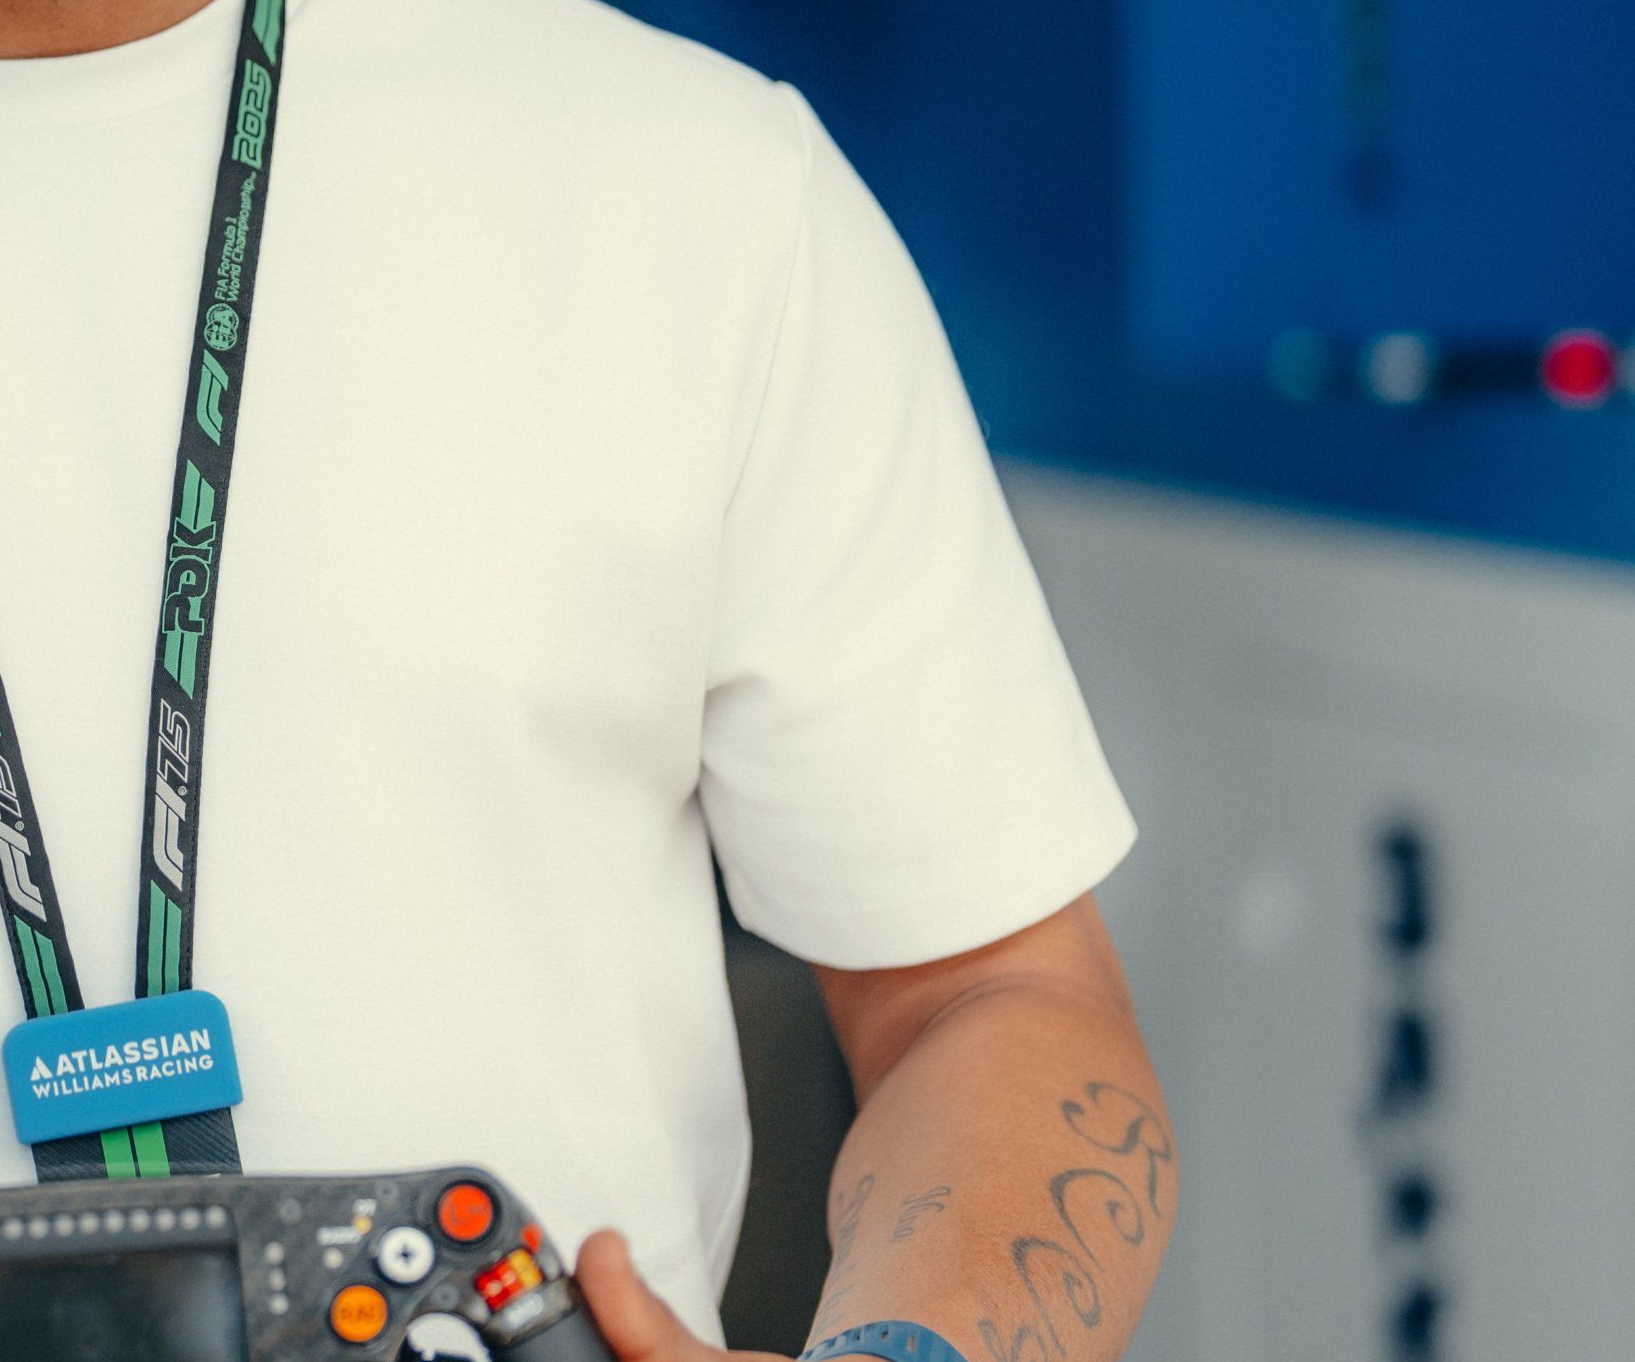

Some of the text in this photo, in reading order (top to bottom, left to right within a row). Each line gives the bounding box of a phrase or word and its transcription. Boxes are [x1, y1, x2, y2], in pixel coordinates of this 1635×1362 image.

[231, 58, 272, 171] 2025
[217, 229, 237, 278] Formula
[226, 263, 242, 303] World
[31, 1054, 214, 1099] WILLIAMS RACING
[55, 1028, 212, 1077] ATLASSIAN
